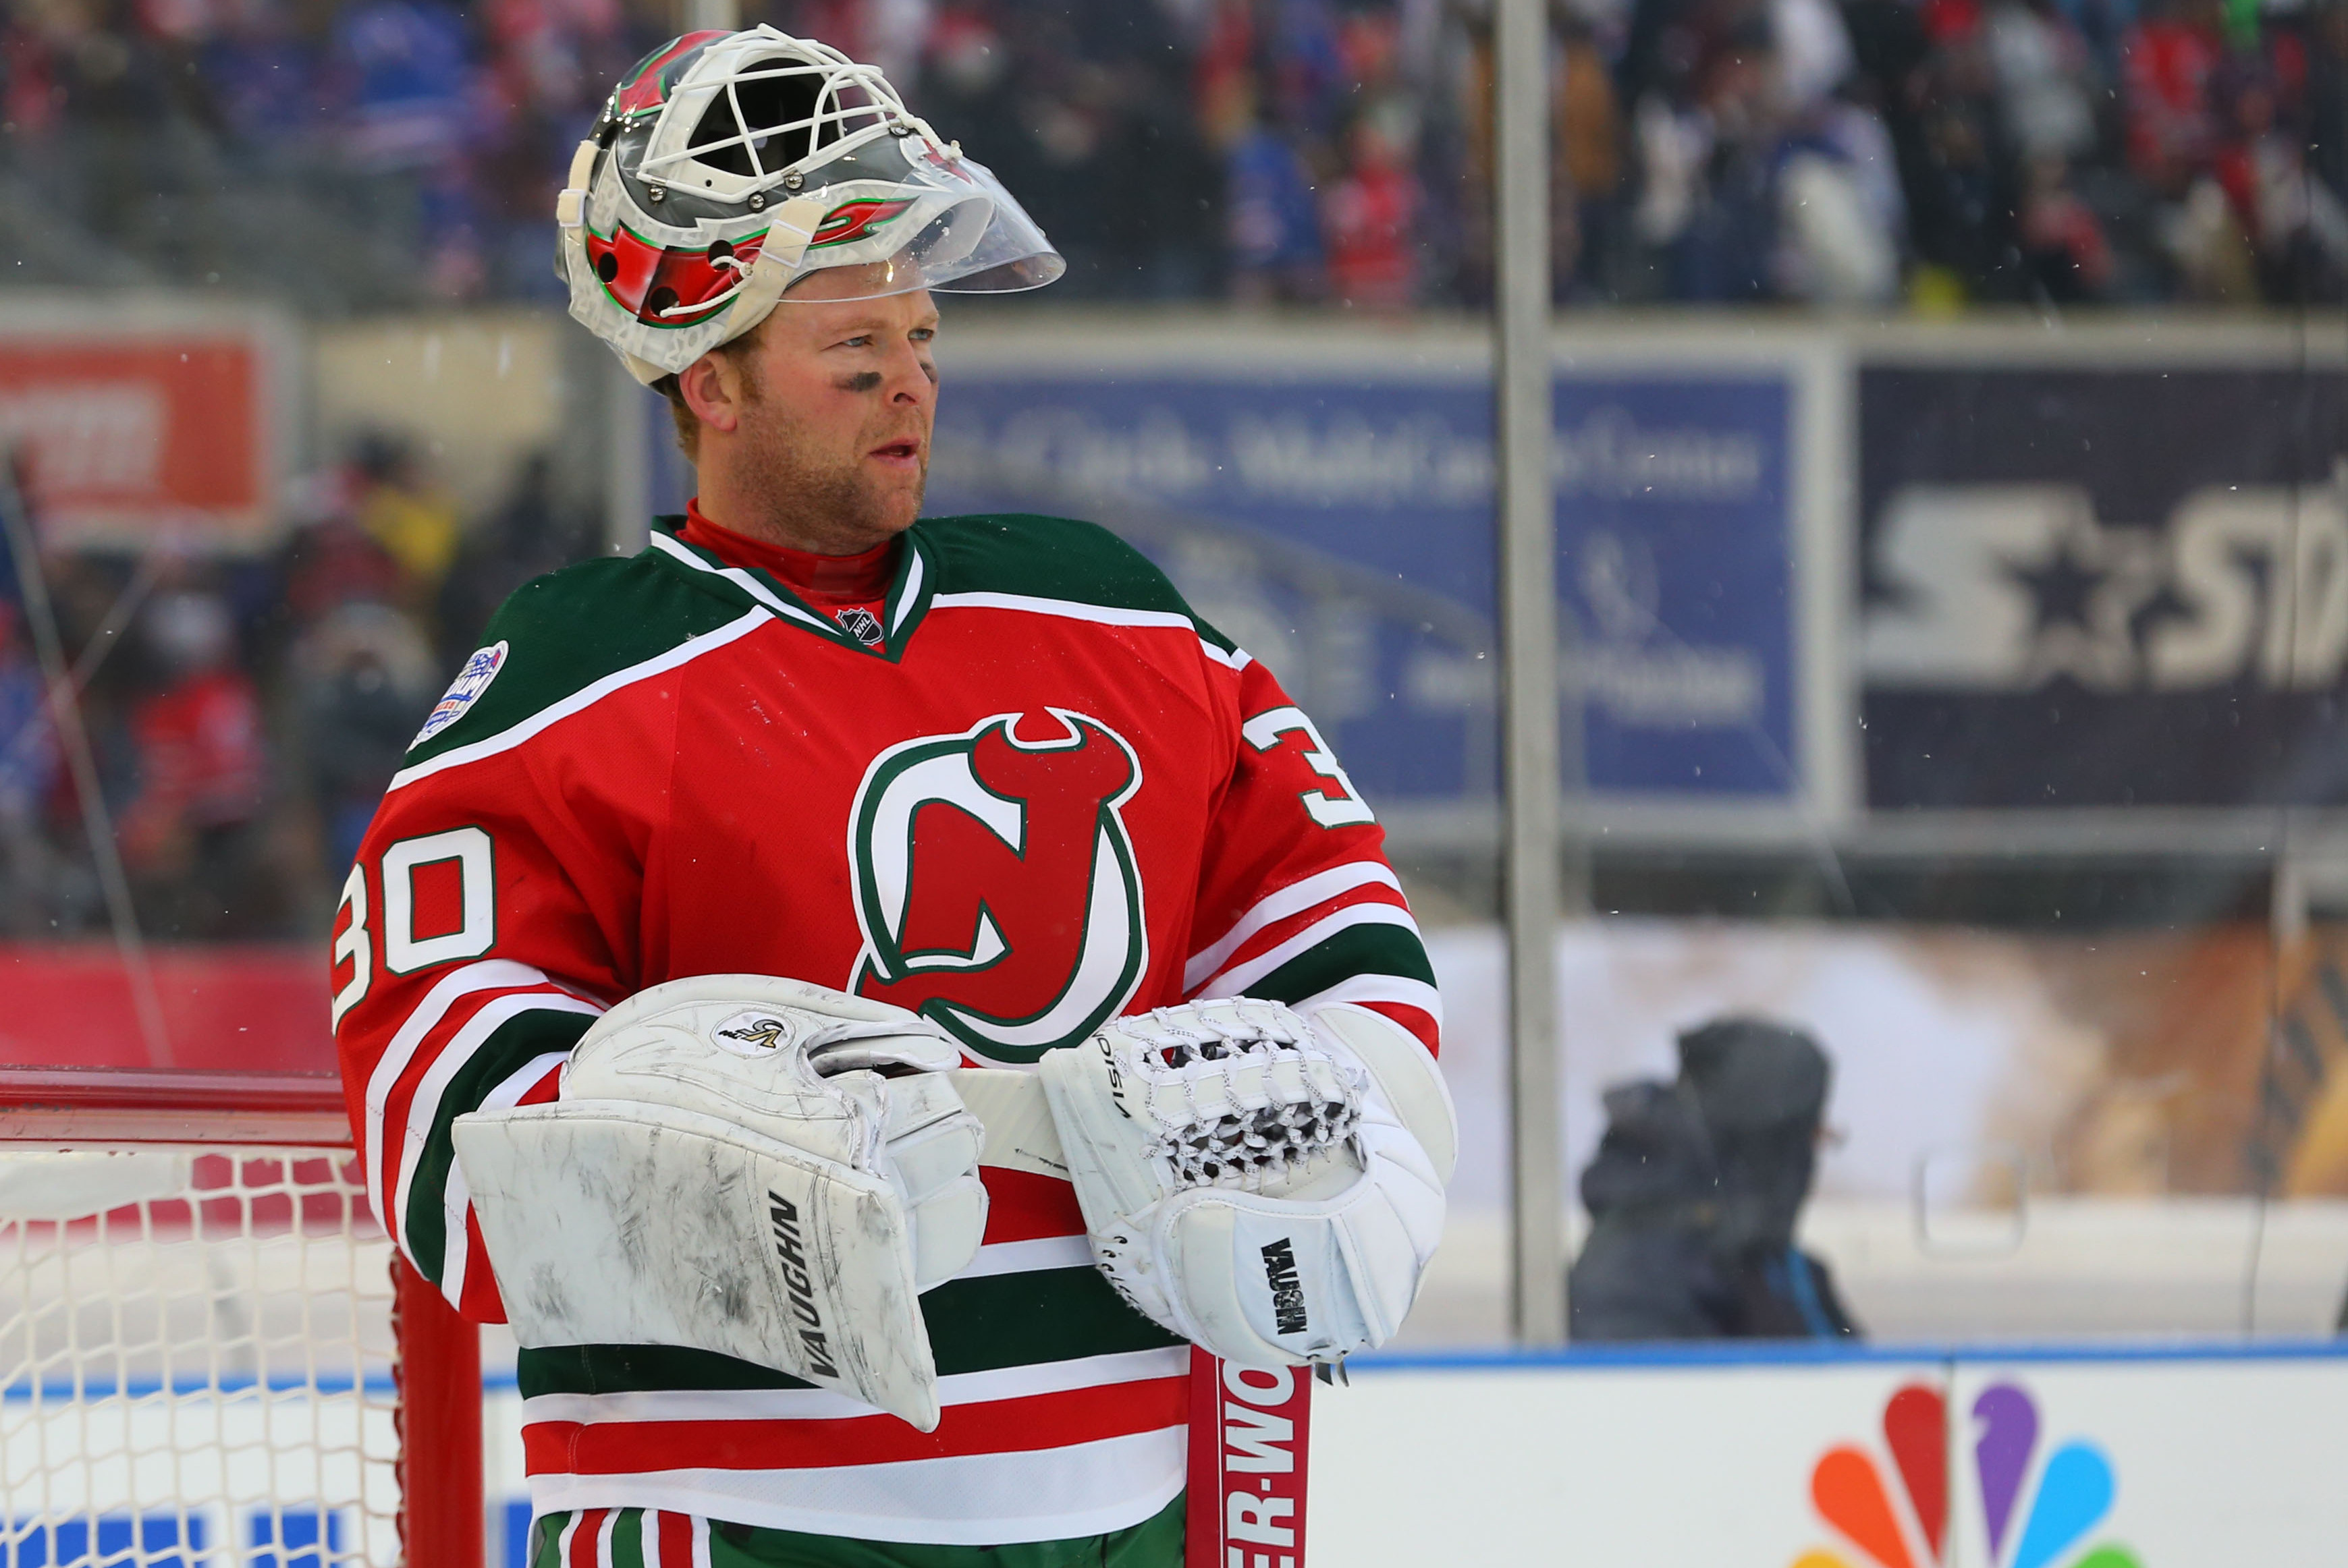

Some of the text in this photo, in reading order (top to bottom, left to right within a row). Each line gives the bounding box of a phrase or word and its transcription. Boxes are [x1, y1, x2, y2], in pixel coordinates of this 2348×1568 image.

[853, 617, 871, 638] NHL
[331, 824, 496, 1038] 30
[769, 1189, 839, 1378] VAUGHN
[1261, 1237, 1307, 1335] VAUGHN
